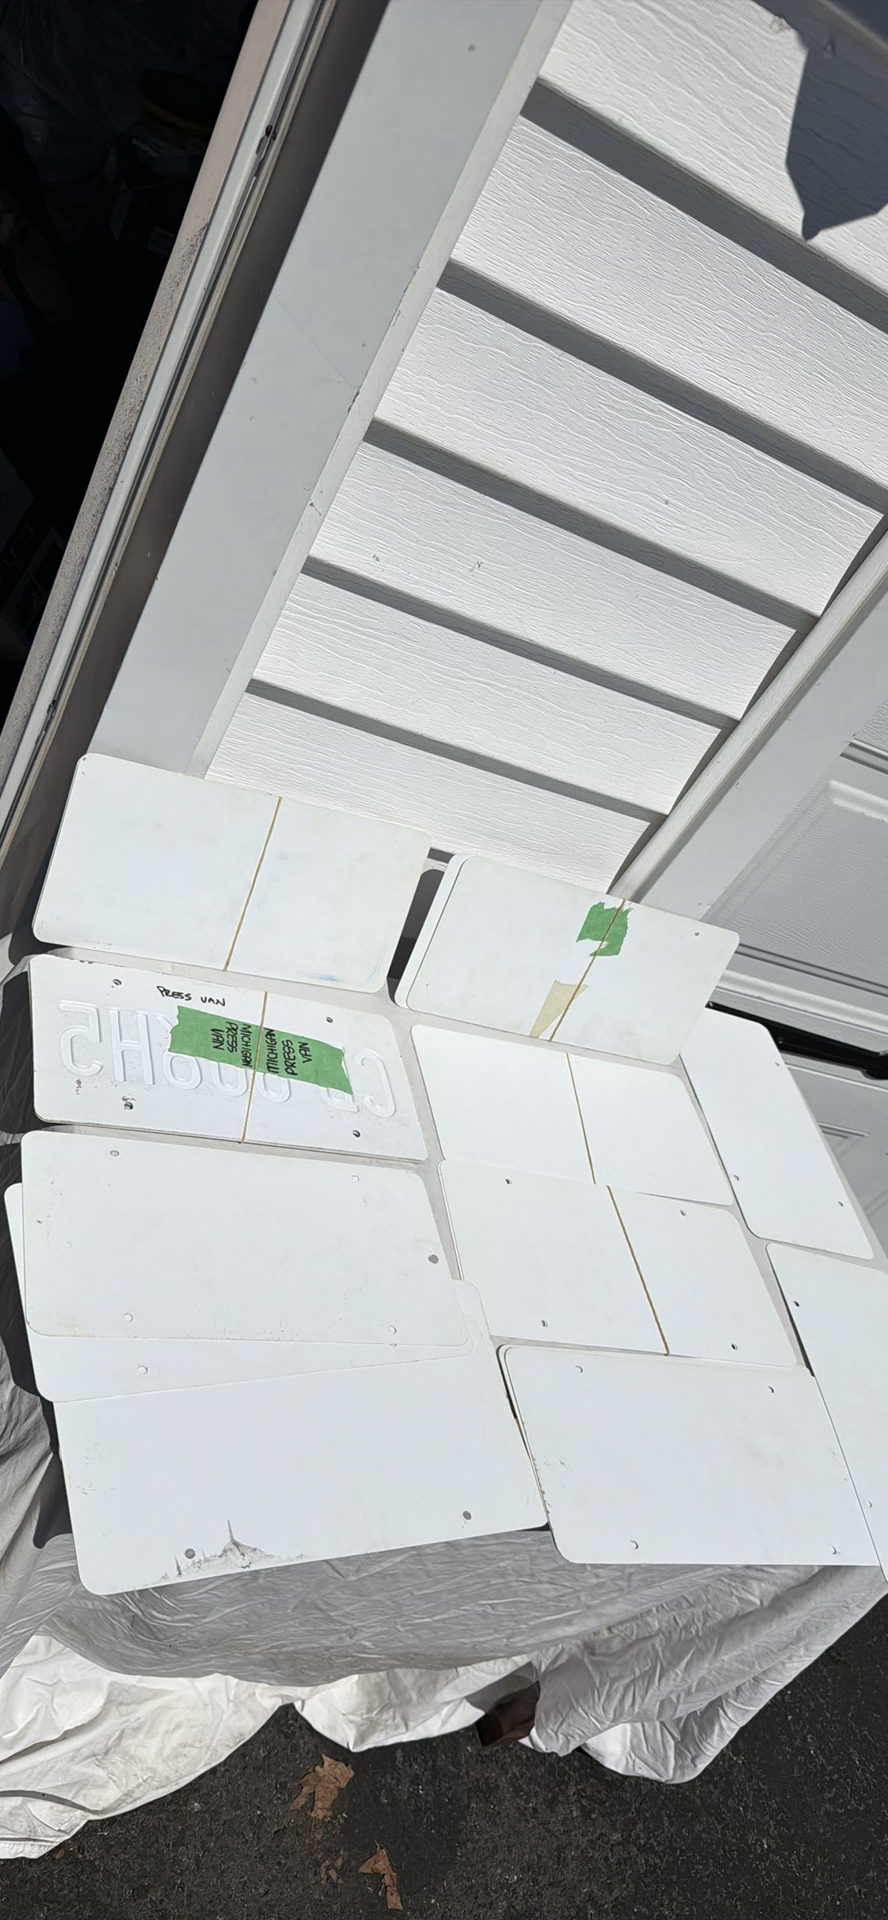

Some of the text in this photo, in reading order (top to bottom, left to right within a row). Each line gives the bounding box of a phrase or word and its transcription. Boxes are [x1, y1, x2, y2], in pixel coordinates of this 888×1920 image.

[157, 986, 192, 1001] PRESS
[210, 1028, 225, 1050] VAN
[226, 1021, 239, 1053] PRESS
[241, 1024, 253, 1068] MICHIGAN
[264, 1028, 280, 1074] MICHIGAN
[298, 1042, 312, 1063] VAN
[282, 1039, 298, 1076] PRESS
